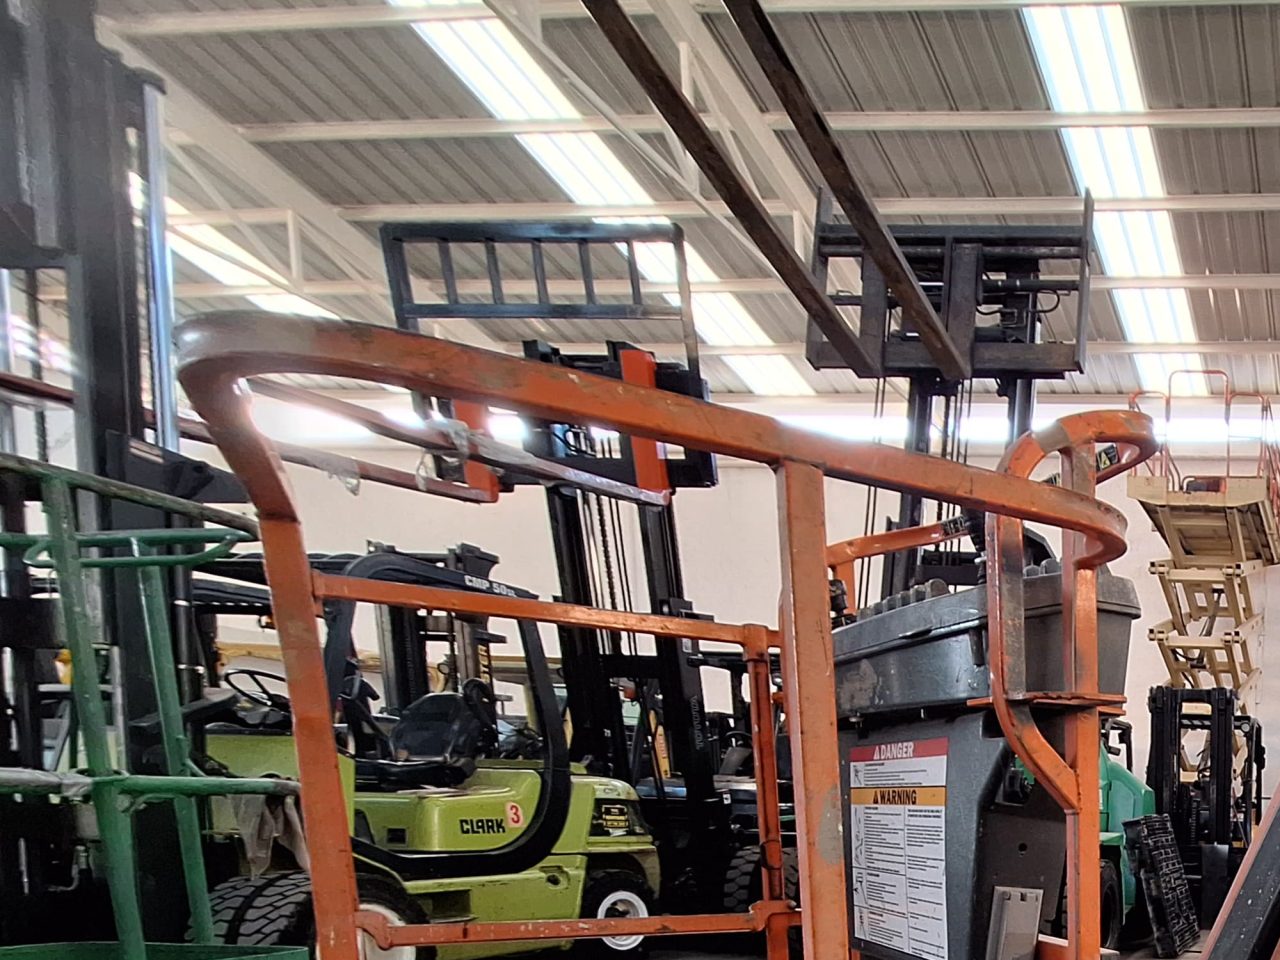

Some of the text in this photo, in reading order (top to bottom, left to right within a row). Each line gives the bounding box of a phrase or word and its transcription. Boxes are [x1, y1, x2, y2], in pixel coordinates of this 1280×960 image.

[464, 575, 490, 590] CMP
[880, 741, 914, 760] DANGER
[880, 789, 917, 805] WARNING
[510, 804, 520, 824] 3
[459, 818, 506, 835] CLARK
